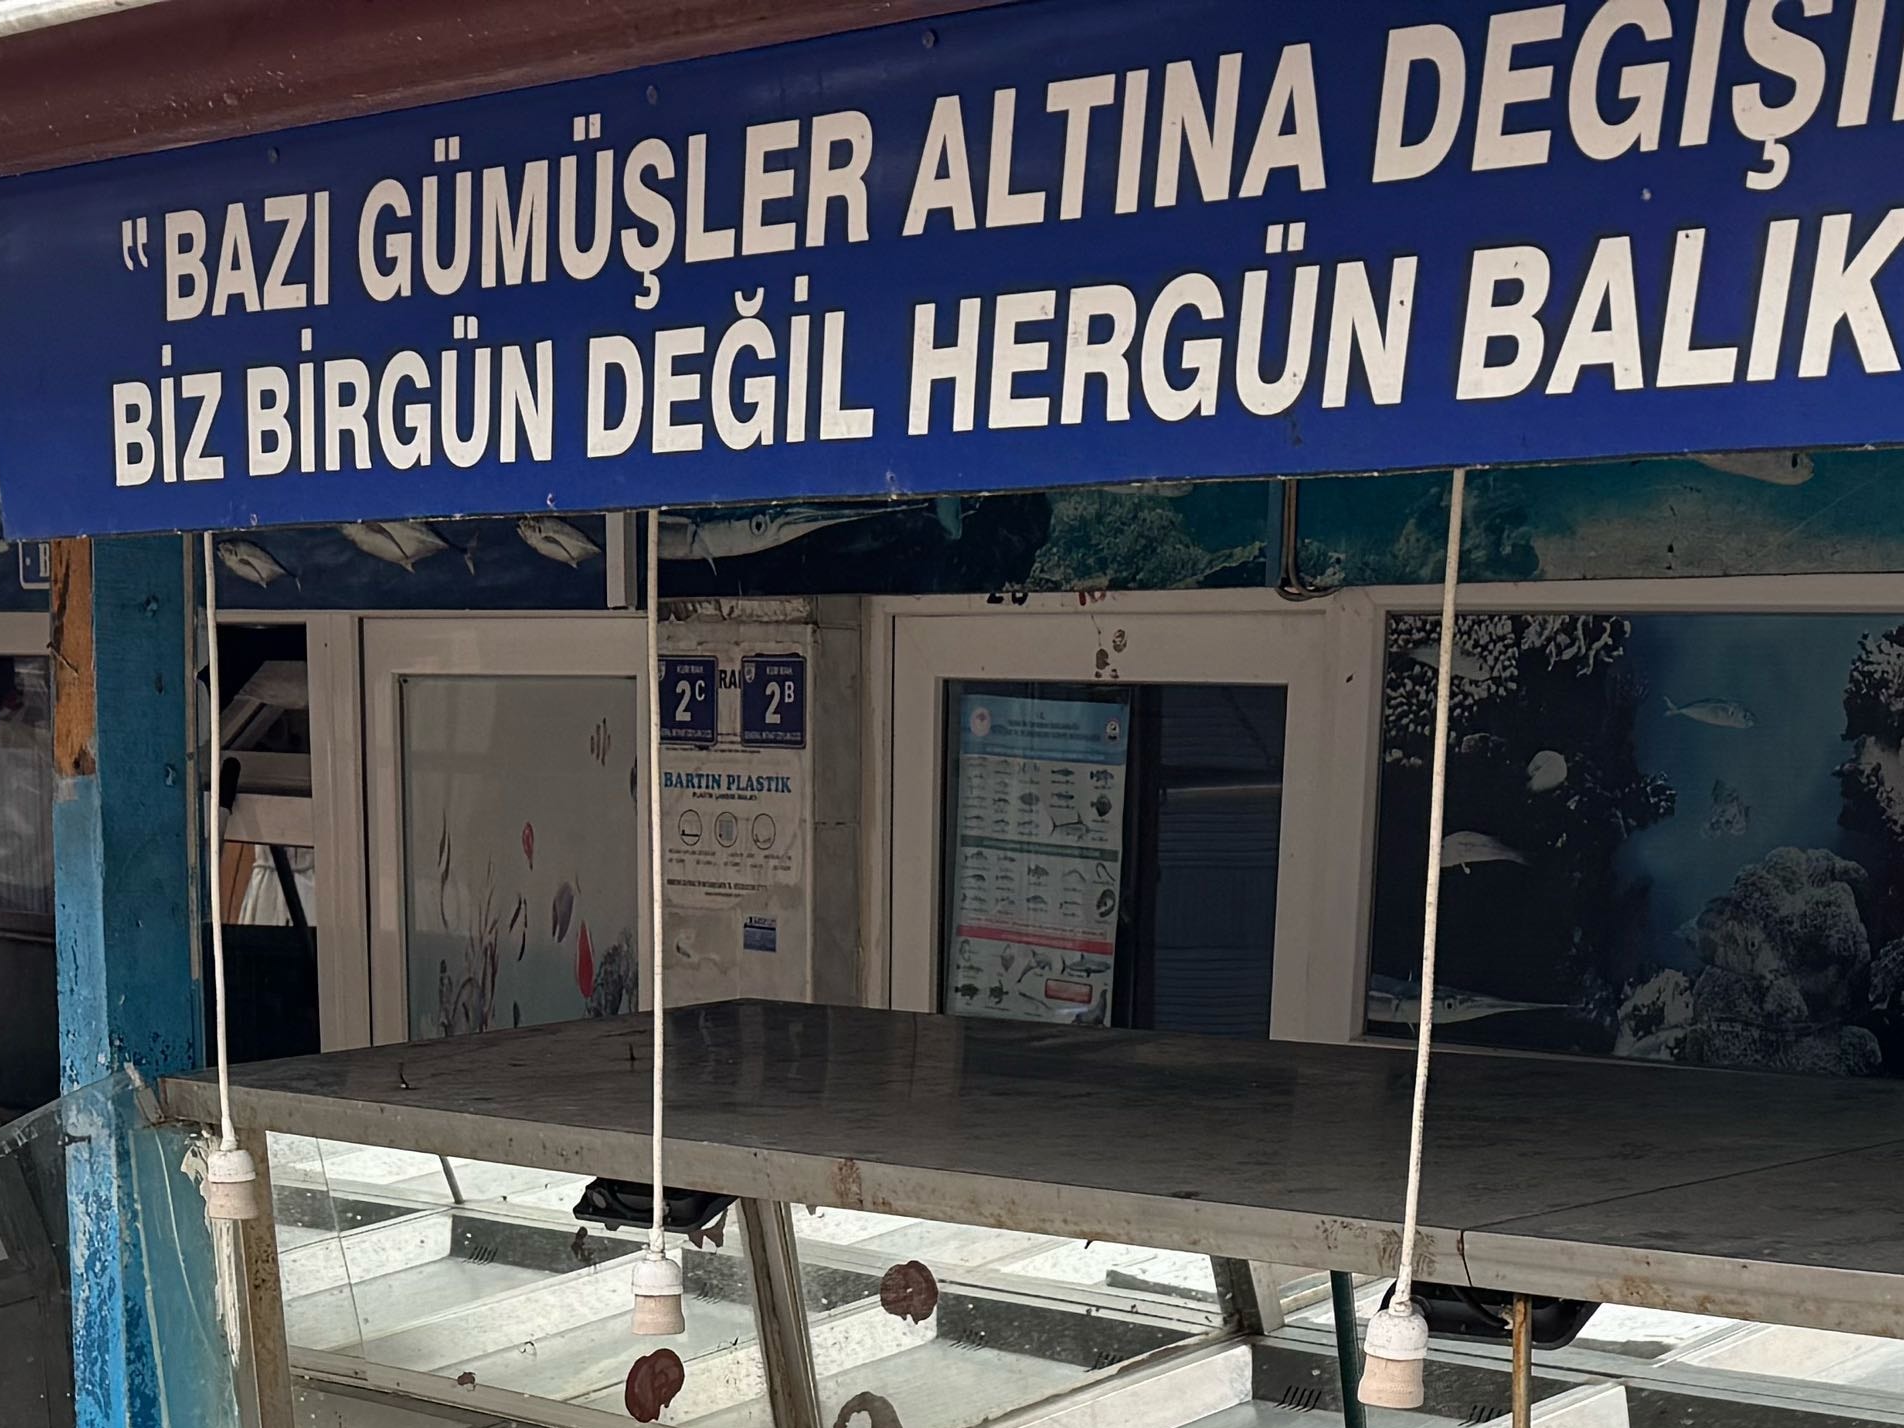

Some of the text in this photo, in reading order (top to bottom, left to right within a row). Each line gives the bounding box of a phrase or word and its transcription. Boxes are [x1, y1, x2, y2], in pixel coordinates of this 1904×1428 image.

[358, 109, 874, 312] GÜMÜŞLER
[902, 42, 1327, 238] ALTINA
[112, 343, 226, 488] BİZ
[245, 315, 554, 477] BİRGÜN
[586, 275, 875, 458] DEĞİL
[907, 221, 1418, 436] HERGÜN
[663, 771, 722, 791] BARTIN
